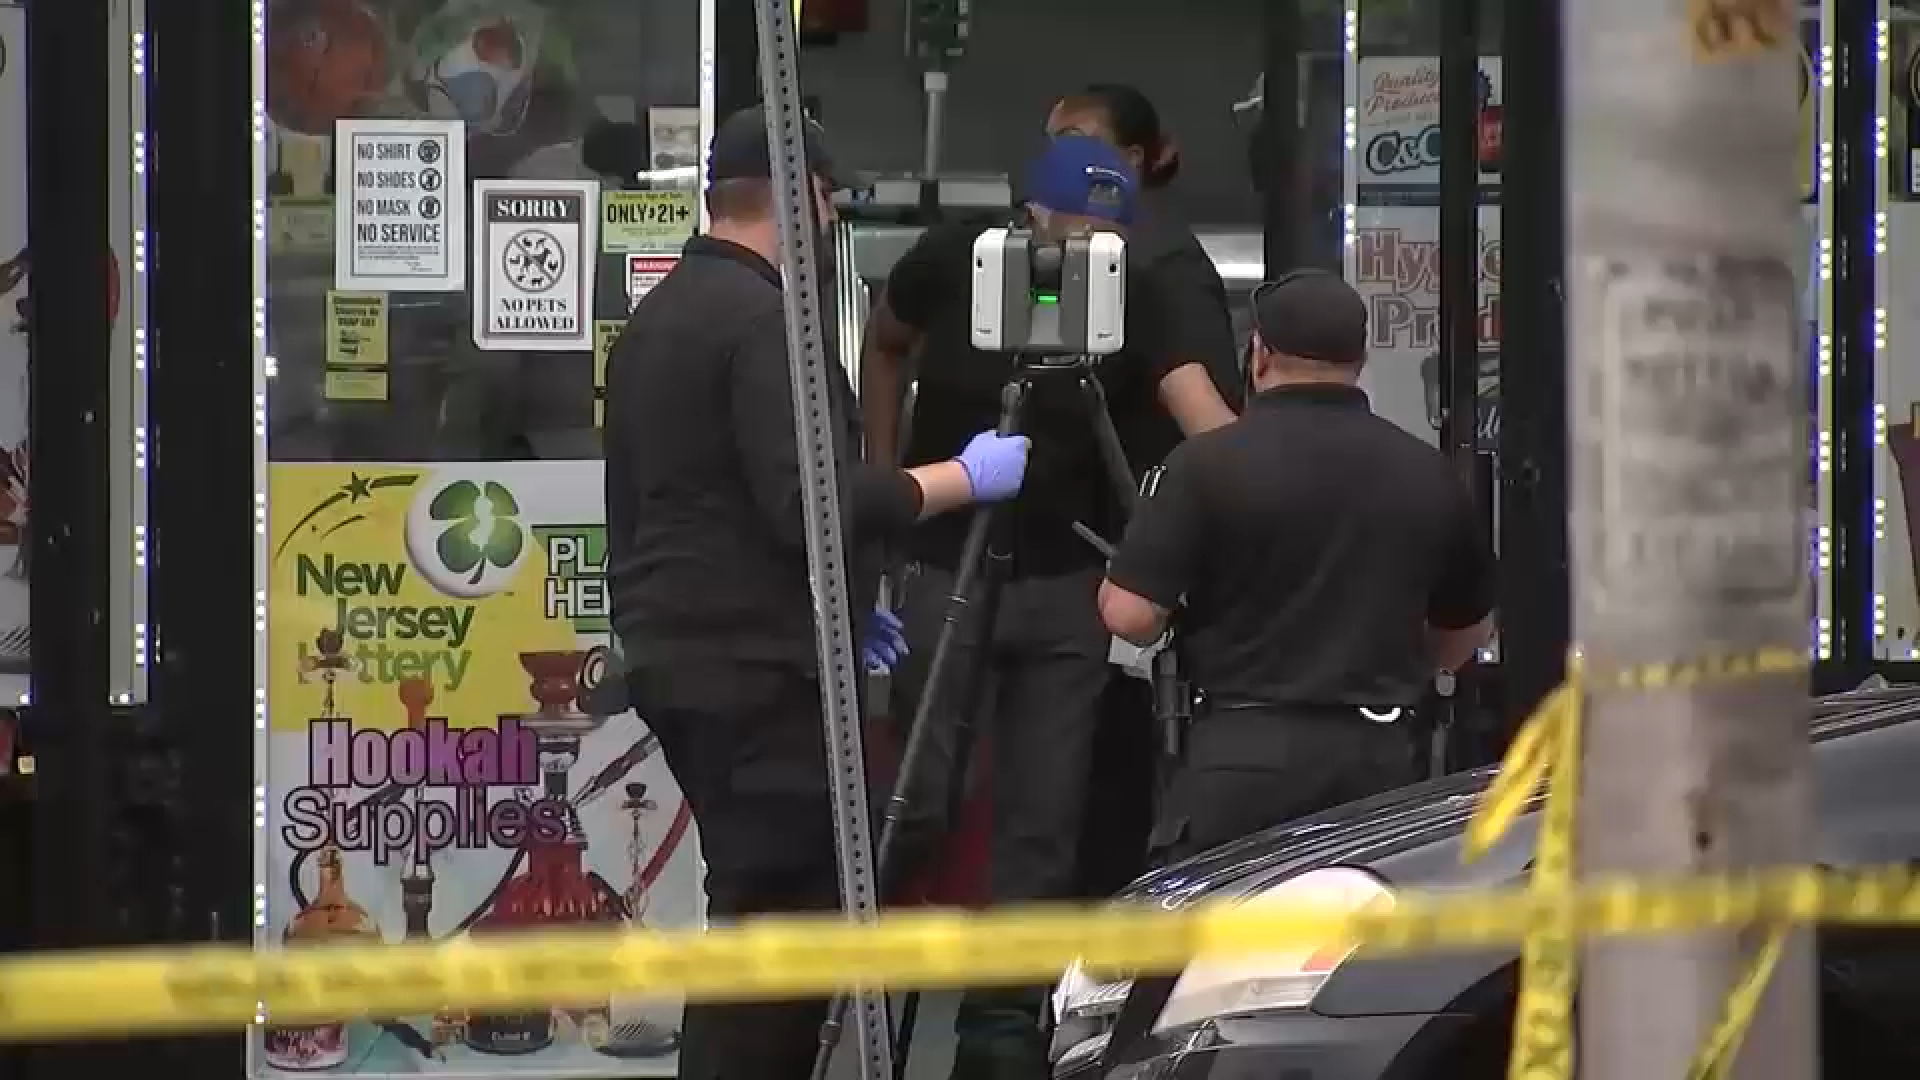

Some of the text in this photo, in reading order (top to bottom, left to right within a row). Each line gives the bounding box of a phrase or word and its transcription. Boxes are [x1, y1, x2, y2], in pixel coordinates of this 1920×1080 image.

[357, 143, 411, 160] NO SHIRT
[357, 171, 416, 188] NO SHOES
[357, 199, 411, 216] NO MASK
[497, 199, 569, 218] SORRY
[606, 203, 690, 224] ONLY 21+
[357, 223, 441, 242] NO SERVICE
[500, 297, 567, 312] NO PETS
[497, 315, 575, 330] ALLOWED
[548, 534, 609, 576] PL
[297, 552, 406, 597] New
[544, 578, 611, 619] HE
[335, 597, 476, 649] Jersey
[297, 640, 473, 692] Lttery
[308, 714, 540, 789] Hookah
[281, 785, 570, 867] Supplies
